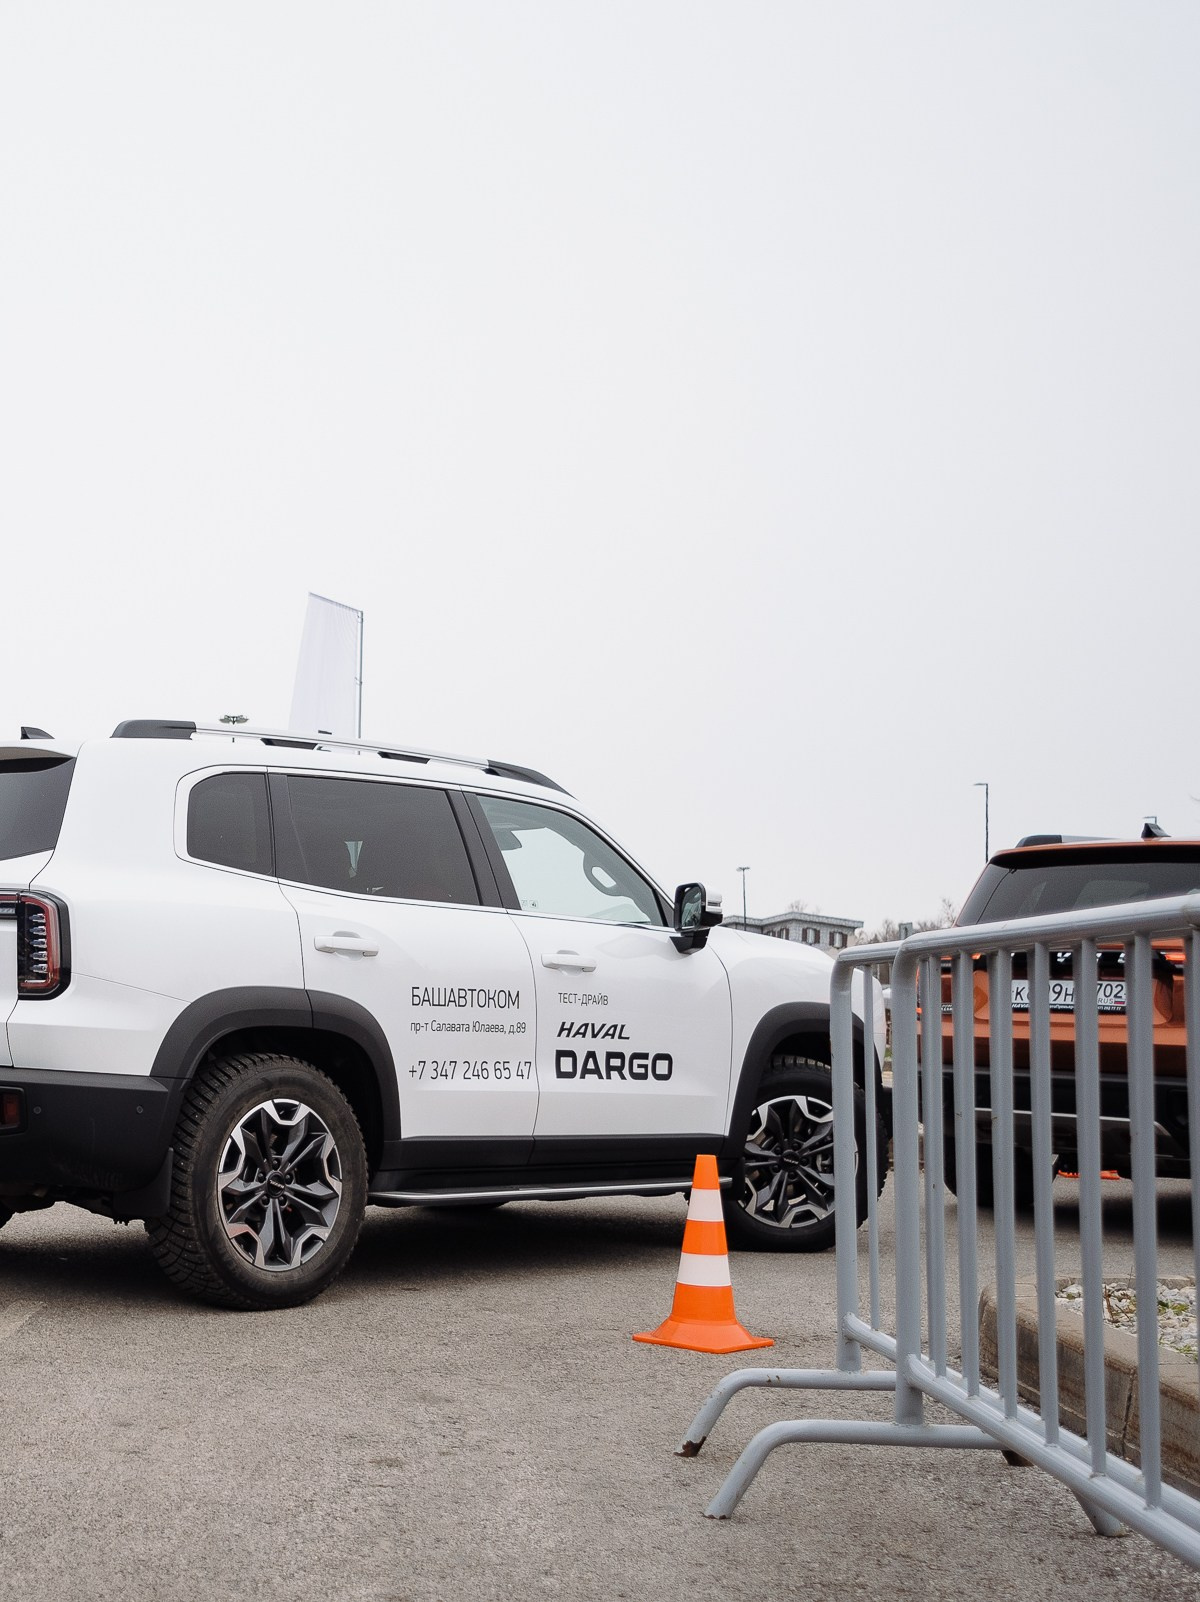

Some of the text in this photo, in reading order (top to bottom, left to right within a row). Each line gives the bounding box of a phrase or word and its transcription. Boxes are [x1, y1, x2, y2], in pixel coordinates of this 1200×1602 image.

[411, 986, 520, 1009] БАШАВТОКОМ
[558, 992, 609, 1006] ТЕСТ-ДРАЙВ
[410, 1020, 527, 1035] пр-т Салавата Юлаева, д.89
[556, 1021, 631, 1041] HAVAL
[408, 1060, 532, 1080] +7 347 246 65 47
[555, 1049, 673, 1081] DARGO
